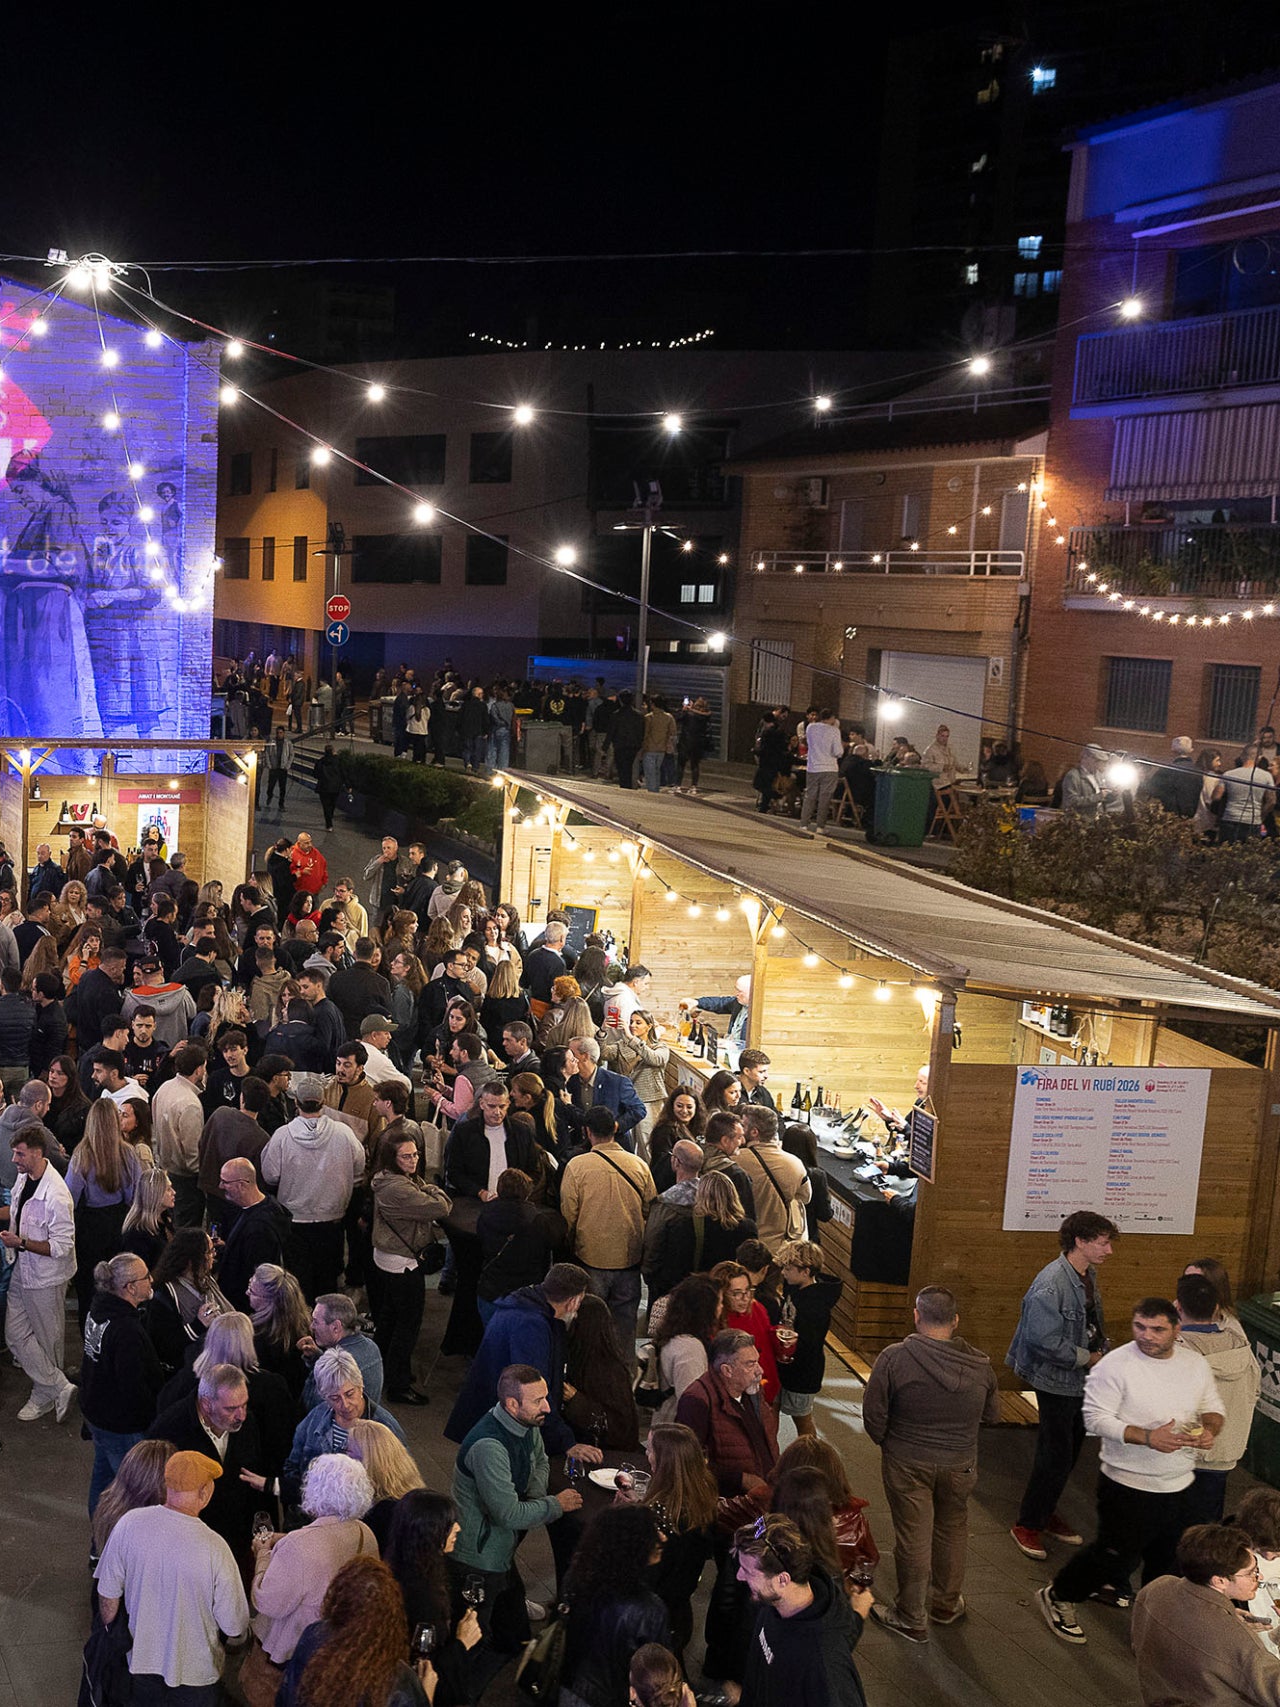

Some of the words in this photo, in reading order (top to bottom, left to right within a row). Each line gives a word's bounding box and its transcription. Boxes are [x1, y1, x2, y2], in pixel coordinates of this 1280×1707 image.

[149, 815, 168, 825] FIRA
[1037, 1078, 1058, 1091] FIRA
[1060, 1078, 1079, 1091] DEL
[1082, 1079, 1091, 1091] VI
[1093, 1076, 1117, 1092] RUBÍ
[1118, 1079, 1140, 1092] 2026
